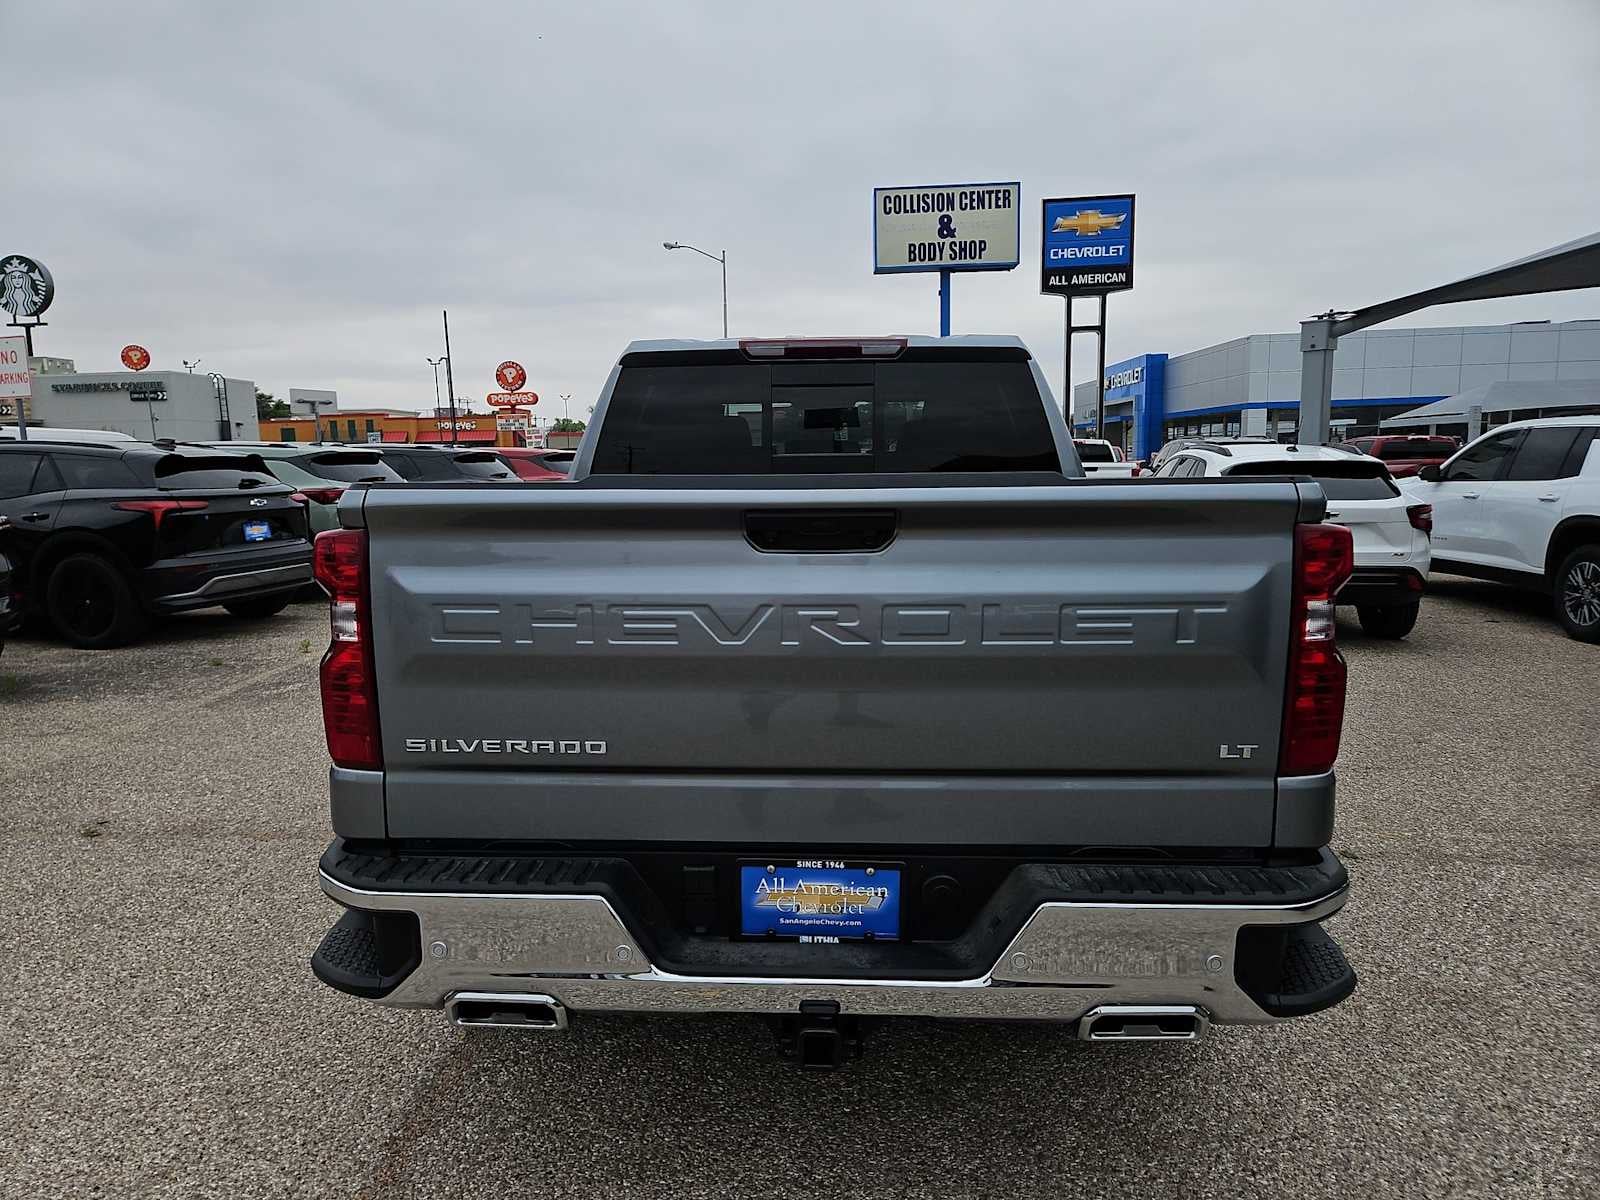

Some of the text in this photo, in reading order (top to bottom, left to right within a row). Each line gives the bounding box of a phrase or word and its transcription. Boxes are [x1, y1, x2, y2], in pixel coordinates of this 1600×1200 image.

[883, 189, 1011, 215] COLLISION CENTER
[937, 214, 957, 239] &
[908, 240, 987, 262] BODY SHOP
[1050, 245, 1125, 259] CHEVROLET
[1049, 272, 1126, 286] ALL AMERICAN
[0, 350, 17, 364] NO
[0, 372, 29, 384] ARKING
[1110, 367, 1142, 389] CHEVROLET
[430, 602, 1228, 647] CHEVROLET
[405, 738, 608, 755] SILVERADO
[1219, 743, 1259, 759] LT
[796, 860, 845, 869] SINCE 1946
[755, 877, 889, 897] All American
[776, 897, 865, 915] Chevrolet
[779, 917, 862, 927] SanAngeloChevy.com
